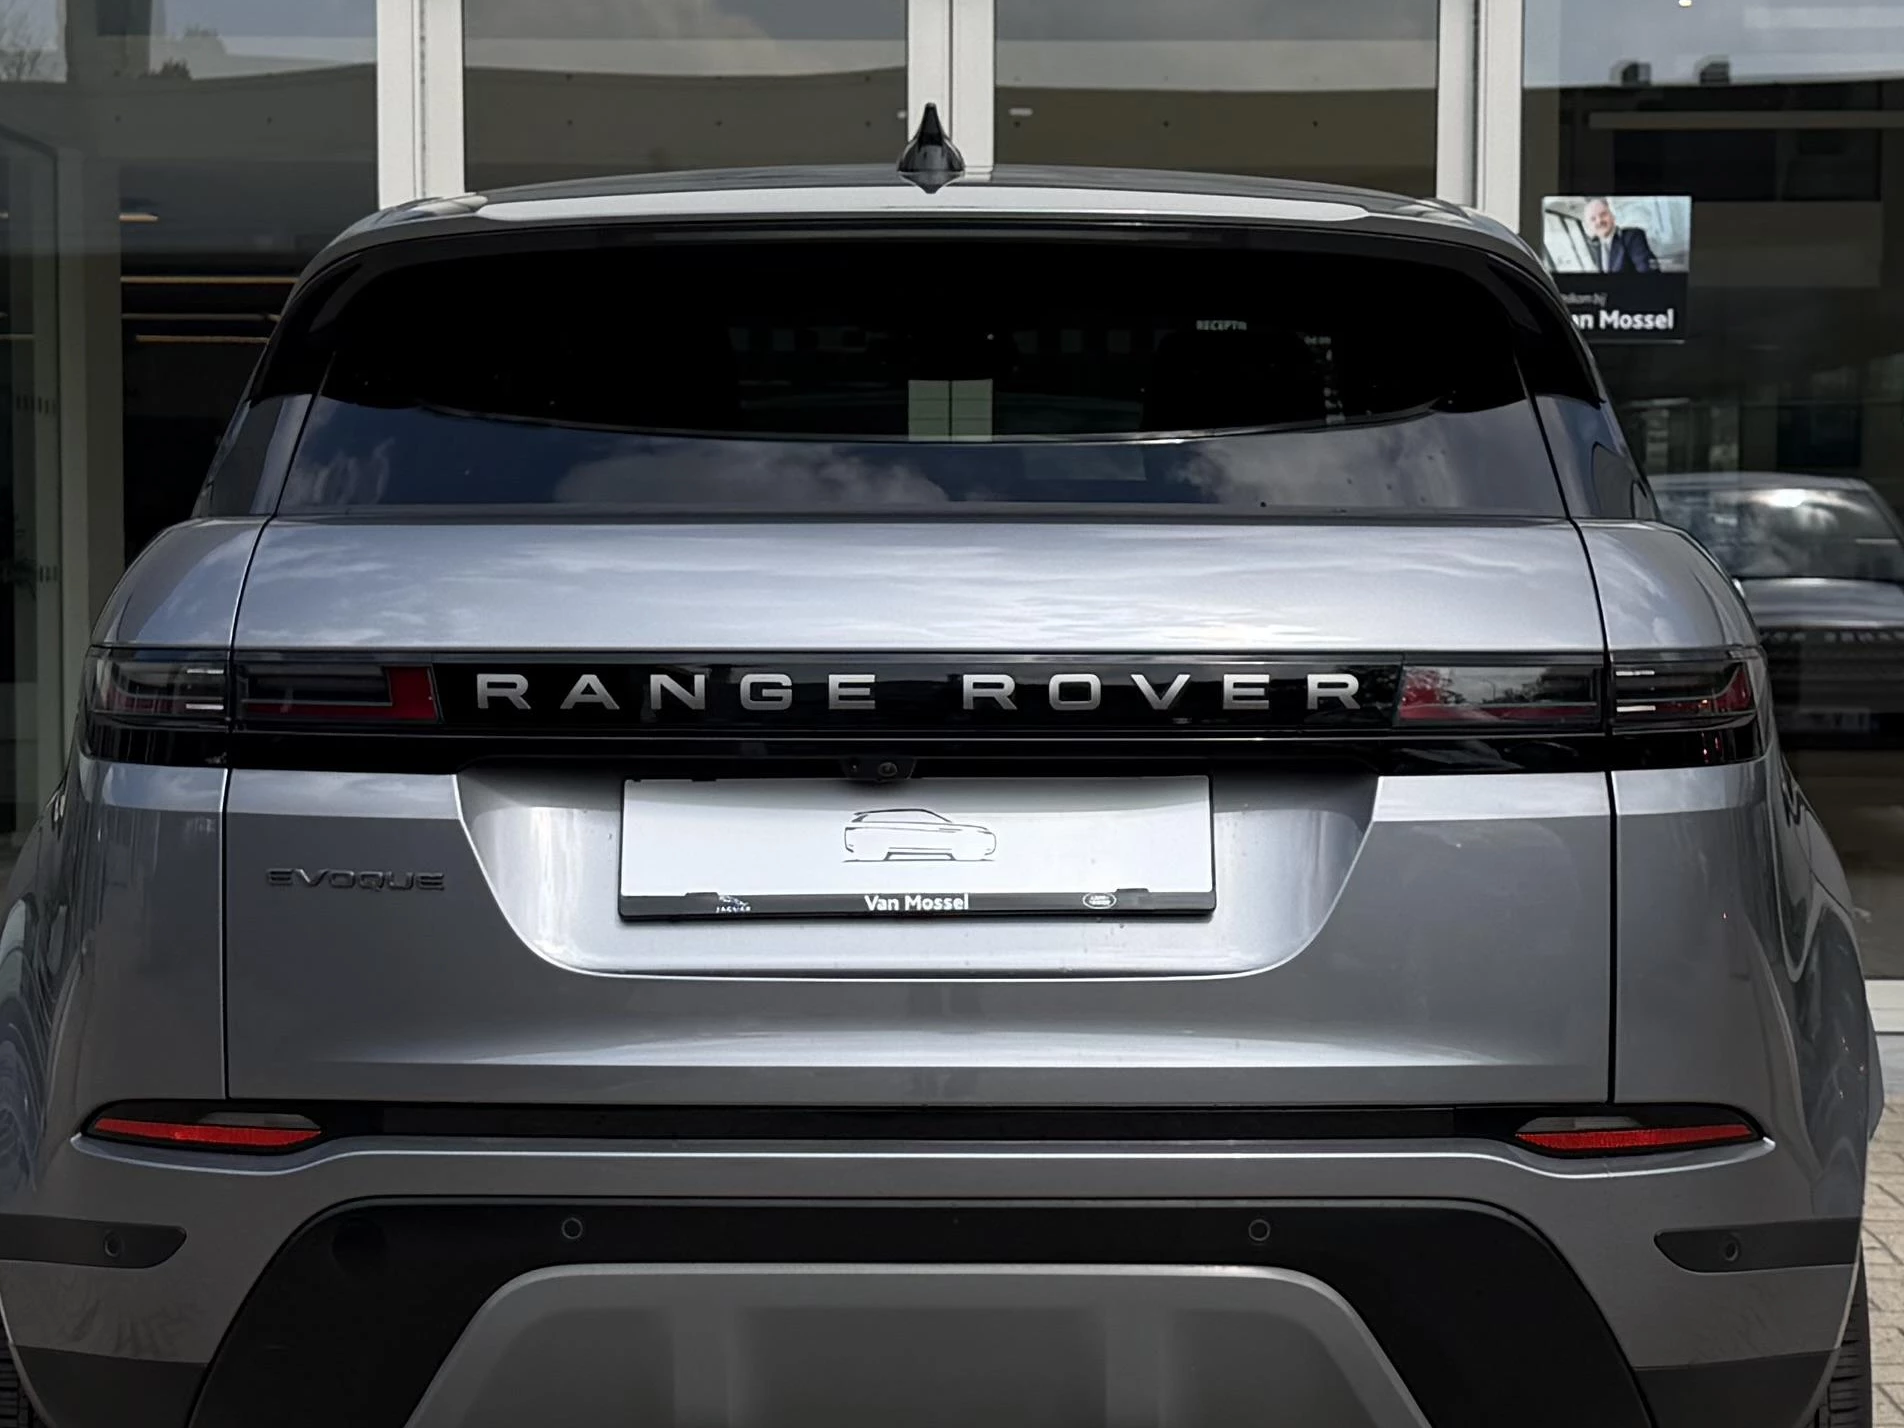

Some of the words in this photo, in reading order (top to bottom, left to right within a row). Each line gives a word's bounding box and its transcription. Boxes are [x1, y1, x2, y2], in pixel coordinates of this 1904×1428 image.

[1599, 308, 1675, 330] Mossel
[476, 672, 878, 711] RANGE
[962, 672, 1361, 712] ROVER
[266, 867, 445, 892] EVOQUE
[864, 894, 899, 911] Van
[904, 893, 969, 911] Mossel
